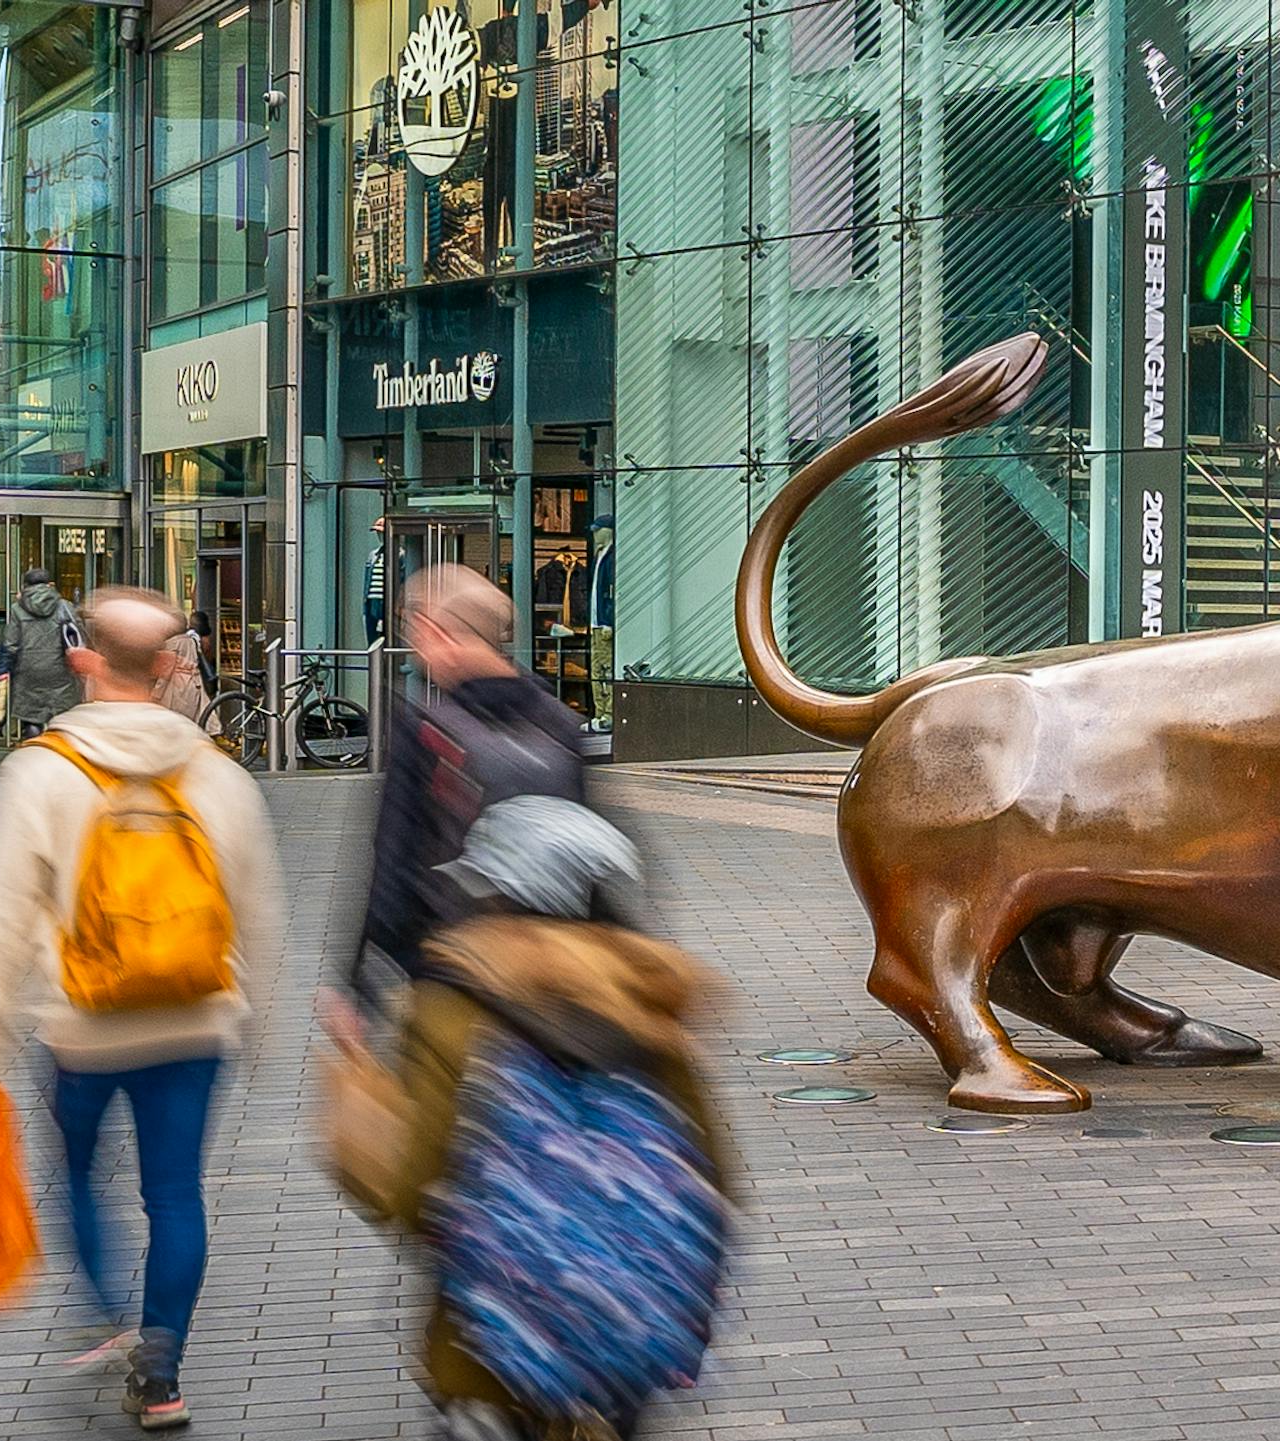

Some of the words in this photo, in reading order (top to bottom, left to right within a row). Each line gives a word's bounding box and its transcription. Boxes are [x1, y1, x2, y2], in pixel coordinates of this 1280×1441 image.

[1144, 160, 1166, 240] NIKE
[372, 353, 470, 410] Timberland
[1143, 244, 1166, 448] BIRMINGHAM
[177, 360, 219, 408] KIKO
[1141, 489, 1164, 565] 2025
[1141, 569, 1163, 638] MAR
